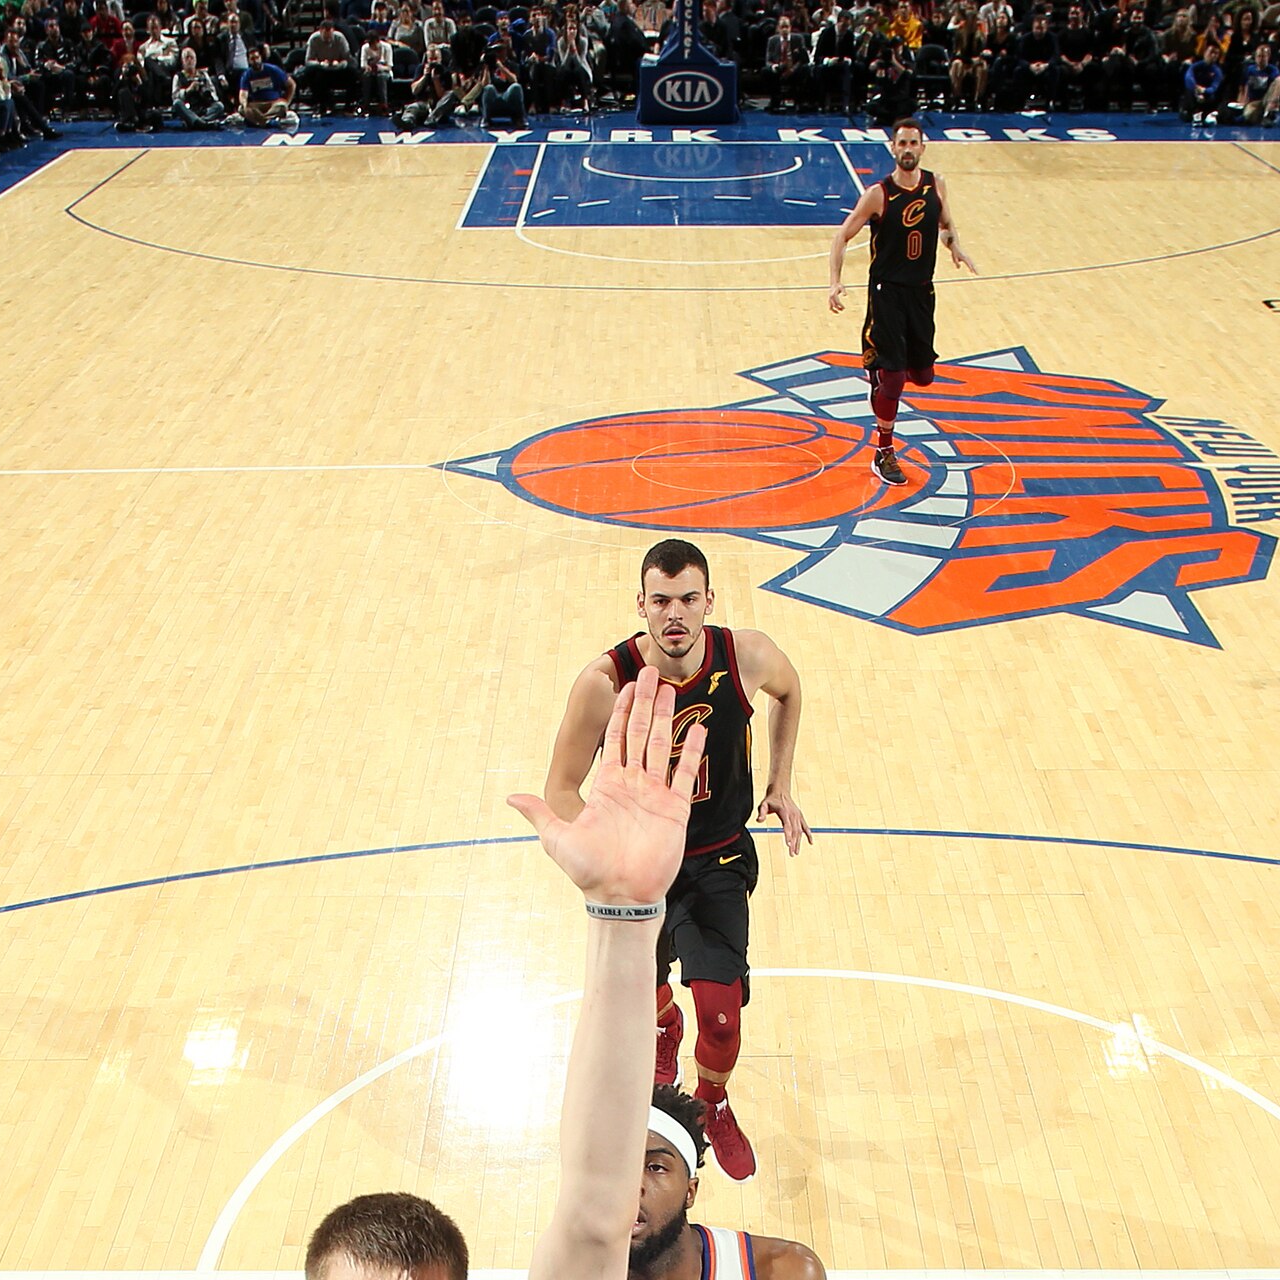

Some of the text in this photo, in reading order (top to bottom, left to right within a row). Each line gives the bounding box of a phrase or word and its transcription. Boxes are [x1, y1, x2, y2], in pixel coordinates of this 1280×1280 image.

[665, 80, 711, 102] KIA
[261, 127, 1117, 146] NEW YORK KNCKS
[902, 199, 926, 227] C
[907, 230, 922, 260] 0
[1163, 415, 1280, 459] NEW
[815, 352, 1260, 628] KNICKS
